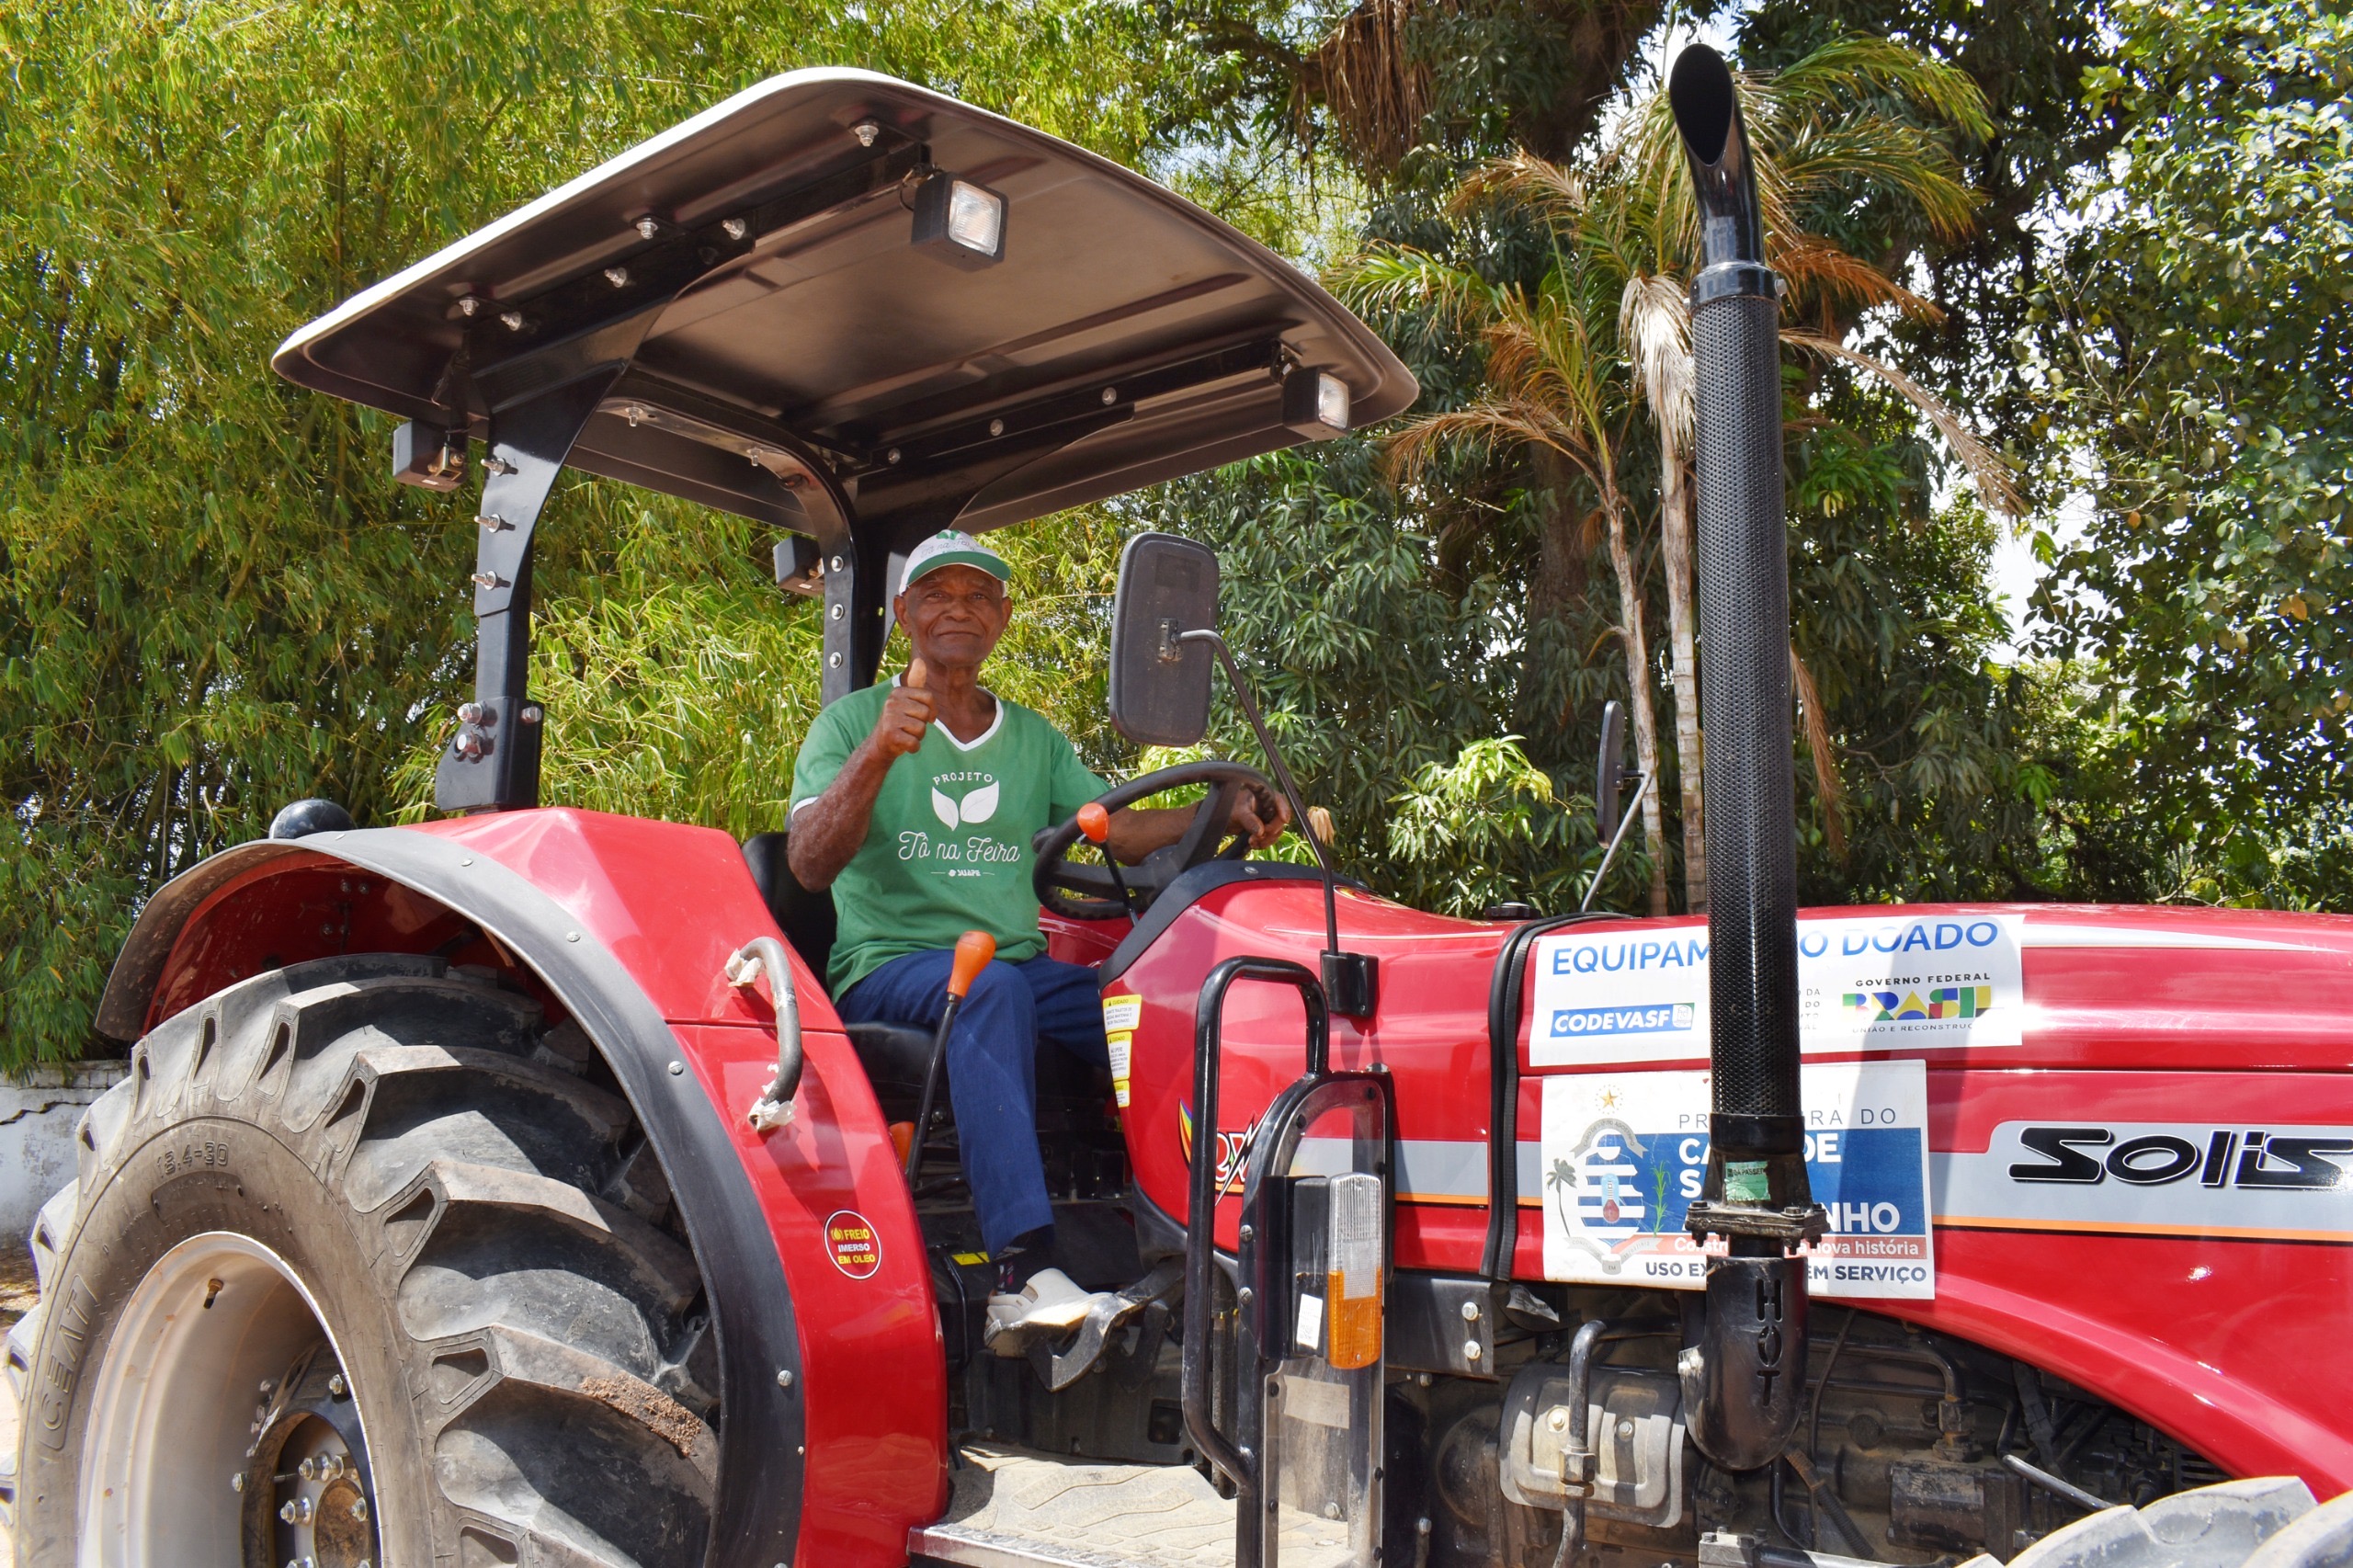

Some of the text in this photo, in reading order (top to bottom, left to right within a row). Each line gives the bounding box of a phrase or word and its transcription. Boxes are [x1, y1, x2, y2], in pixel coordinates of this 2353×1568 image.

[933, 772, 993, 785] PROJETO
[898, 831, 1020, 862] Tô na Feira
[1843, 922, 1998, 956] DOADO
[1856, 972, 1991, 987] GOVERNO FEDERAL
[1554, 1010, 1670, 1032] CODEVASF
[1860, 1108, 1896, 1125] DO
[844, 1228, 870, 1240] FREIO
[837, 1243, 870, 1253] IMERSO
[1855, 1239, 1919, 1256] história
[837, 1254, 876, 1265] EM OLEO
[1645, 1261, 1683, 1277] USO
[1835, 1266, 1927, 1284] SERVIÇO
[1756, 1278, 1783, 1407] HOT
